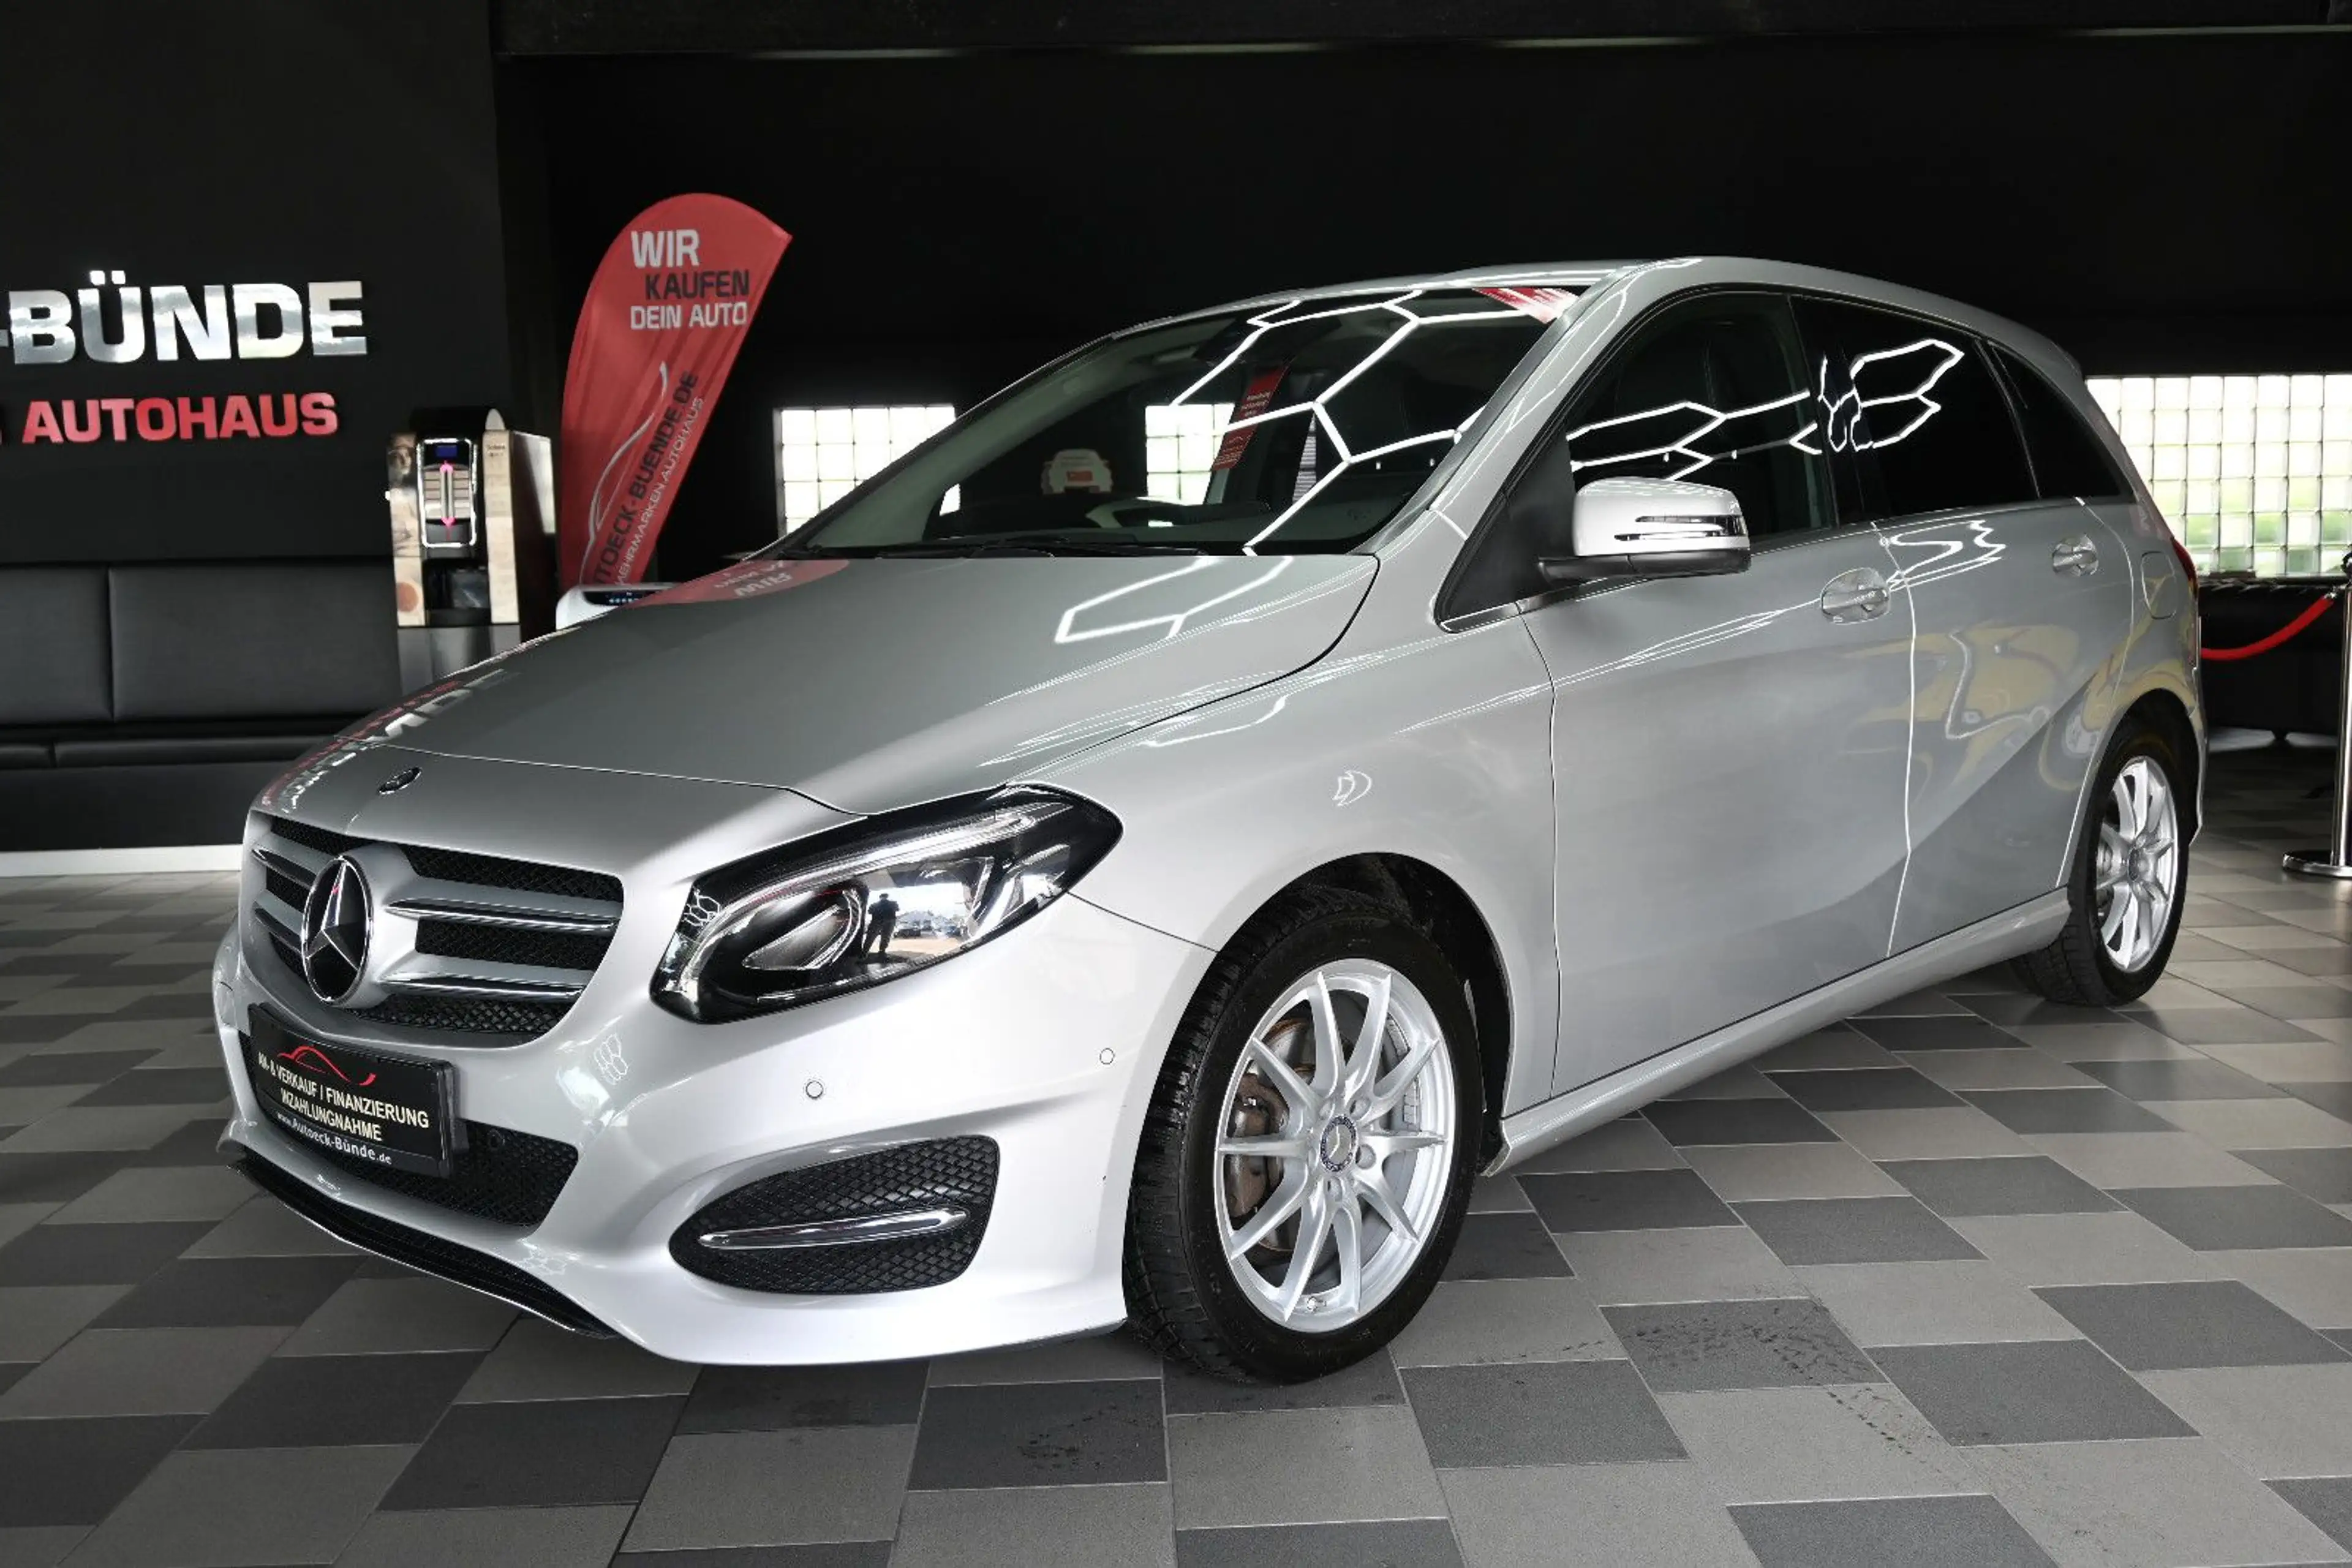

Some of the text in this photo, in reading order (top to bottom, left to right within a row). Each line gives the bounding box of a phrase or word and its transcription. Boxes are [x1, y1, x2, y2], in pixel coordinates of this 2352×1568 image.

[630, 229, 700, 268] WIR
[645, 270, 750, 300] KAUFEN
[630, 301, 748, 330] DEIN AUTO
[22, 392, 339, 443] AUTOHAUS
[661, 396, 704, 482] AUTOHAUS
[594, 370, 698, 584] TOECK-BUENDE.DE
[276, 1064, 318, 1098] VERKAUF
[326, 1087, 429, 1129] FINANZIERUNG
